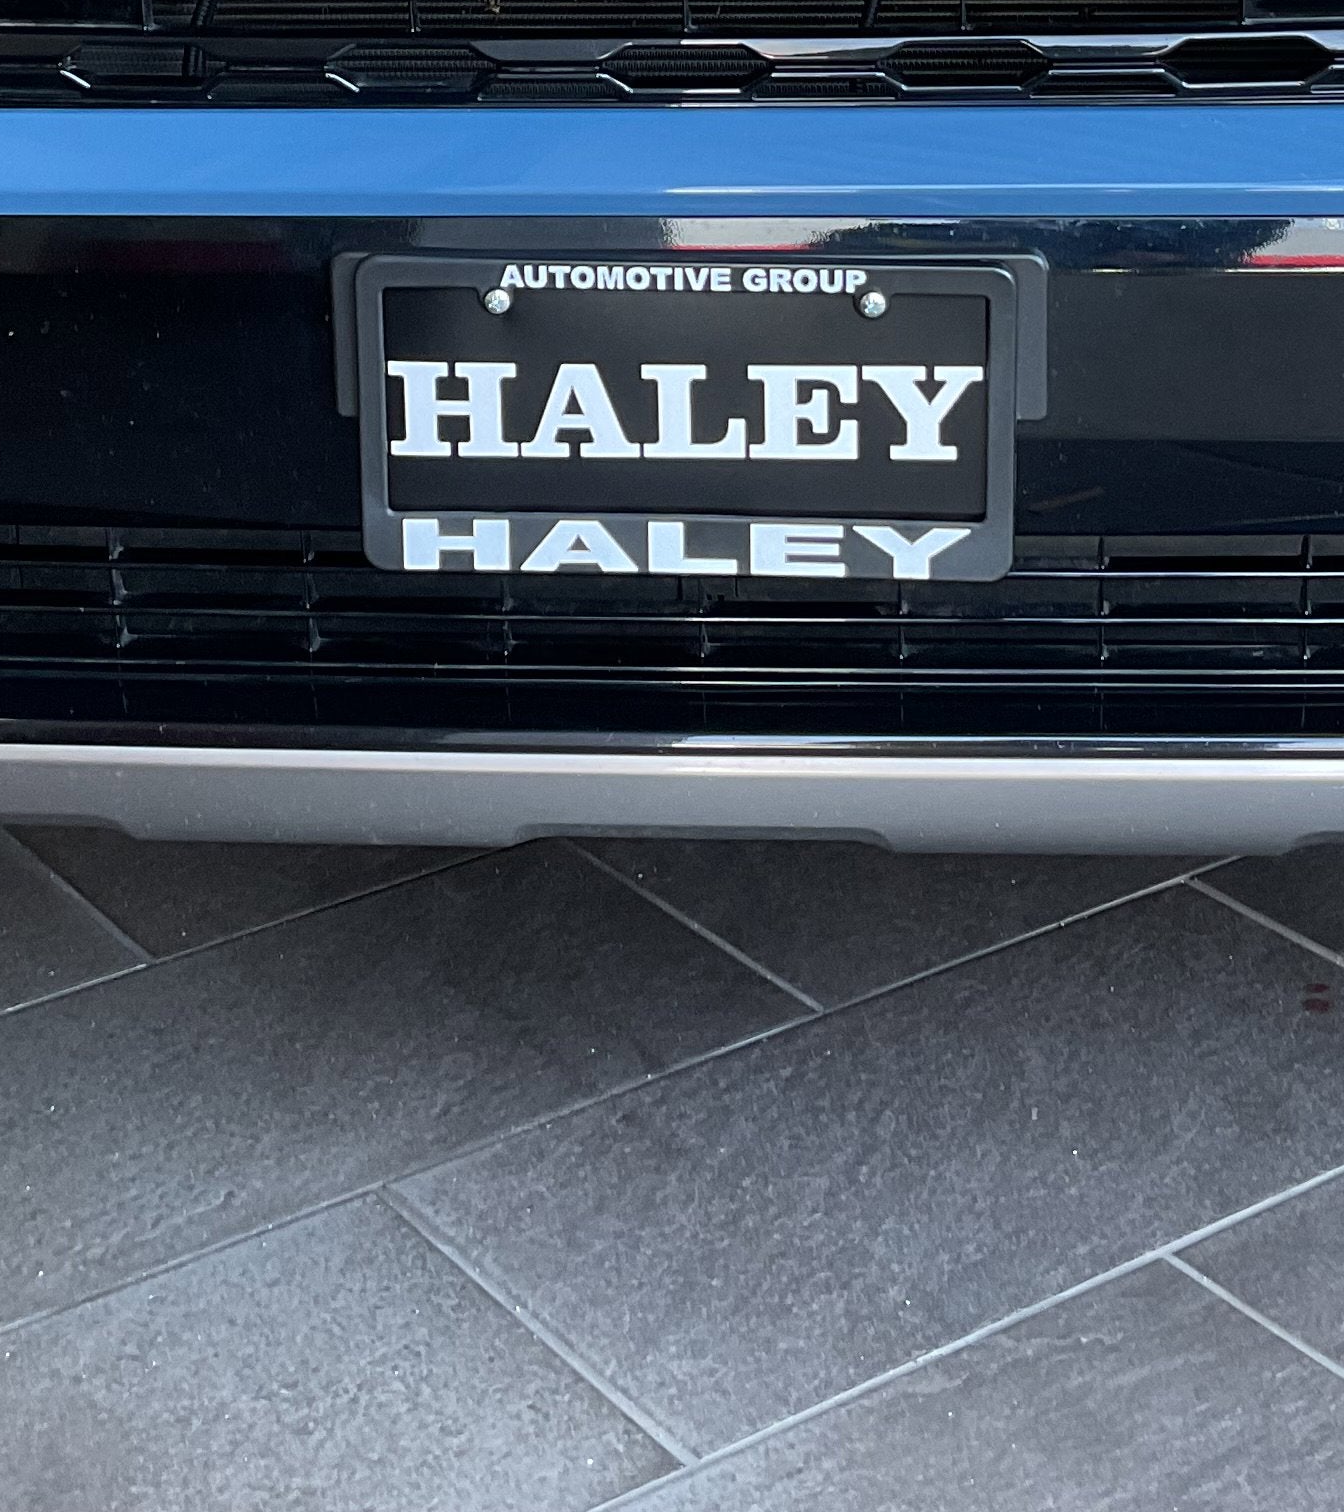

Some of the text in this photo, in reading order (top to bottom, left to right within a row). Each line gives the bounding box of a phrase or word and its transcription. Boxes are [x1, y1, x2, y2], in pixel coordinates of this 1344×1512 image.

[500, 264, 868, 294] AUTOMOTIVE GROUP
[387, 360, 984, 462] HALEY
[401, 517, 973, 581] HALEY
